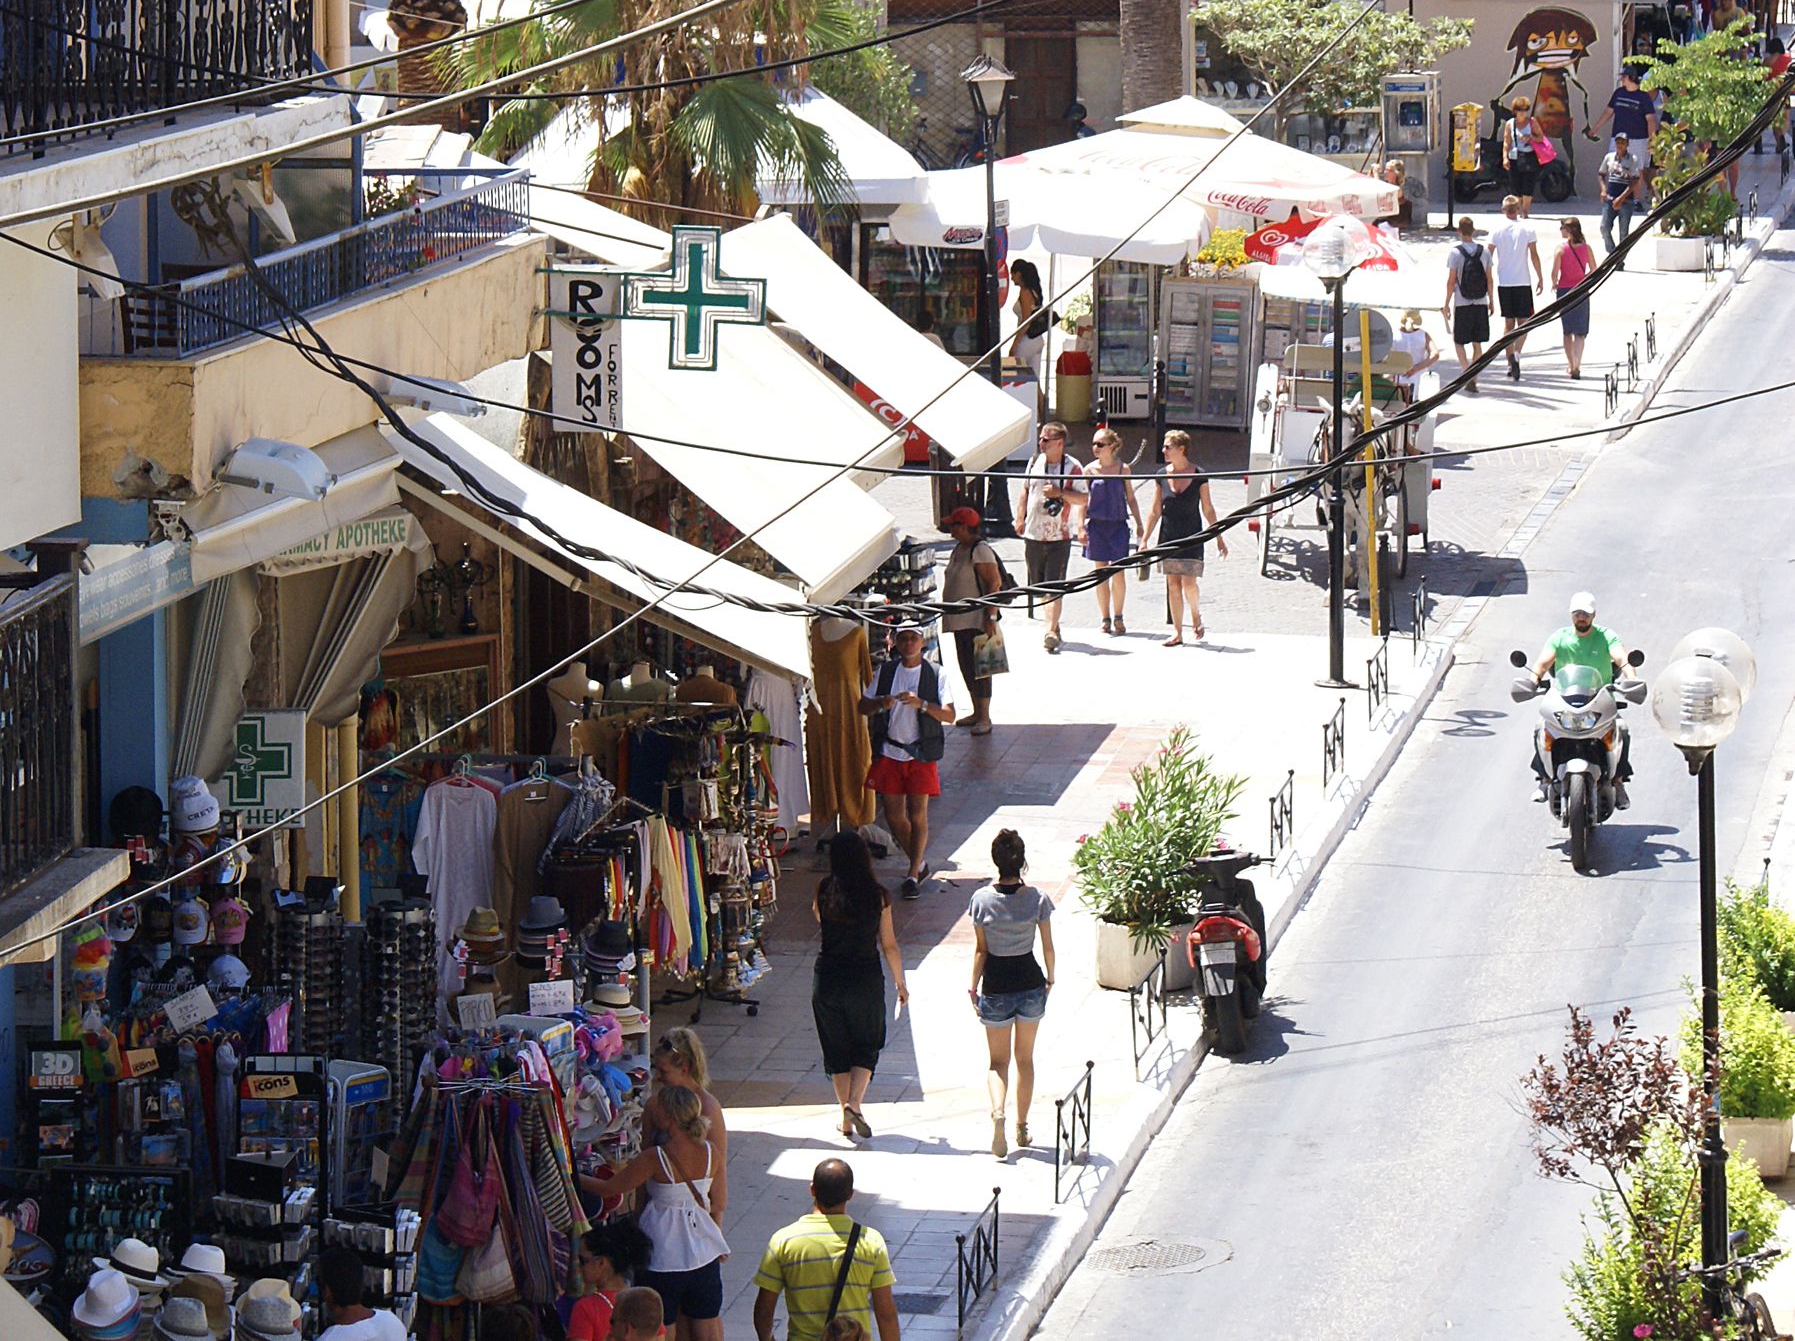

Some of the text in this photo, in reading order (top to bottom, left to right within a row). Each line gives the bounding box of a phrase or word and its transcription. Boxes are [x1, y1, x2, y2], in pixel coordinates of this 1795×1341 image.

[568, 279, 604, 424] ROOMS
[607, 343, 618, 387] FOR
[335, 518, 406, 550] APOTHEKE
[40, 1052, 74, 1075] 3D
[38, 1075, 76, 1086] GREECE
[252, 1076, 291, 1092] icons
